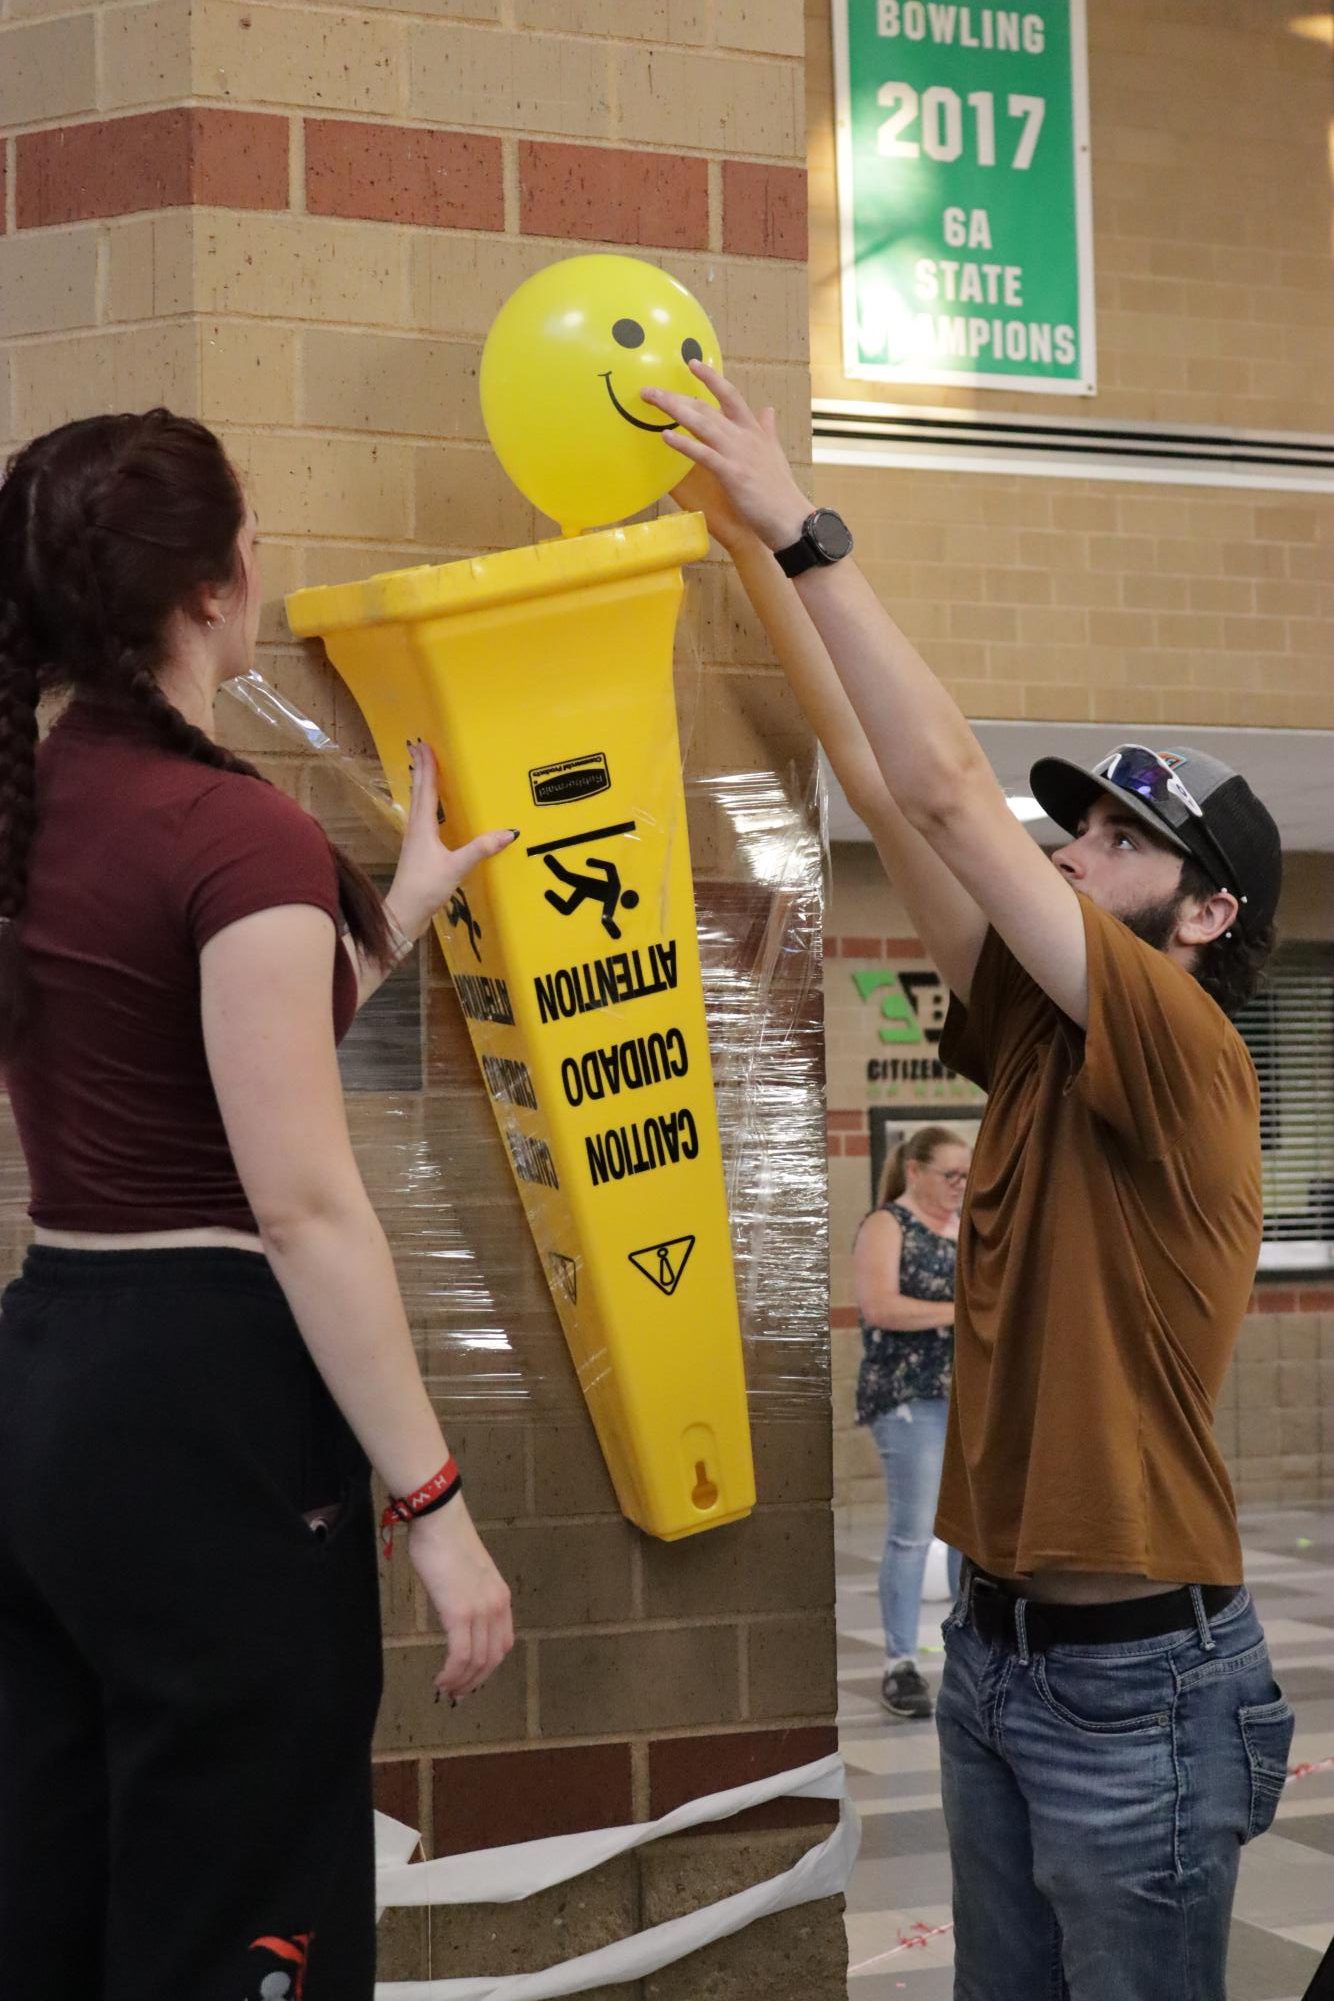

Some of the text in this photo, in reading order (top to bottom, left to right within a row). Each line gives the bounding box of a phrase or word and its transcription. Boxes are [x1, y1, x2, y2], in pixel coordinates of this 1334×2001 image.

[878, 0, 1045, 54] BOWLING
[876, 81, 1046, 170] 2017
[943, 206, 992, 250] 6A
[913, 258, 1023, 307] STATE
[534, 940, 678, 1024] ATTENTION
[561, 1027, 689, 1107] CUIDADO
[585, 1108, 699, 1186] CAUTION
